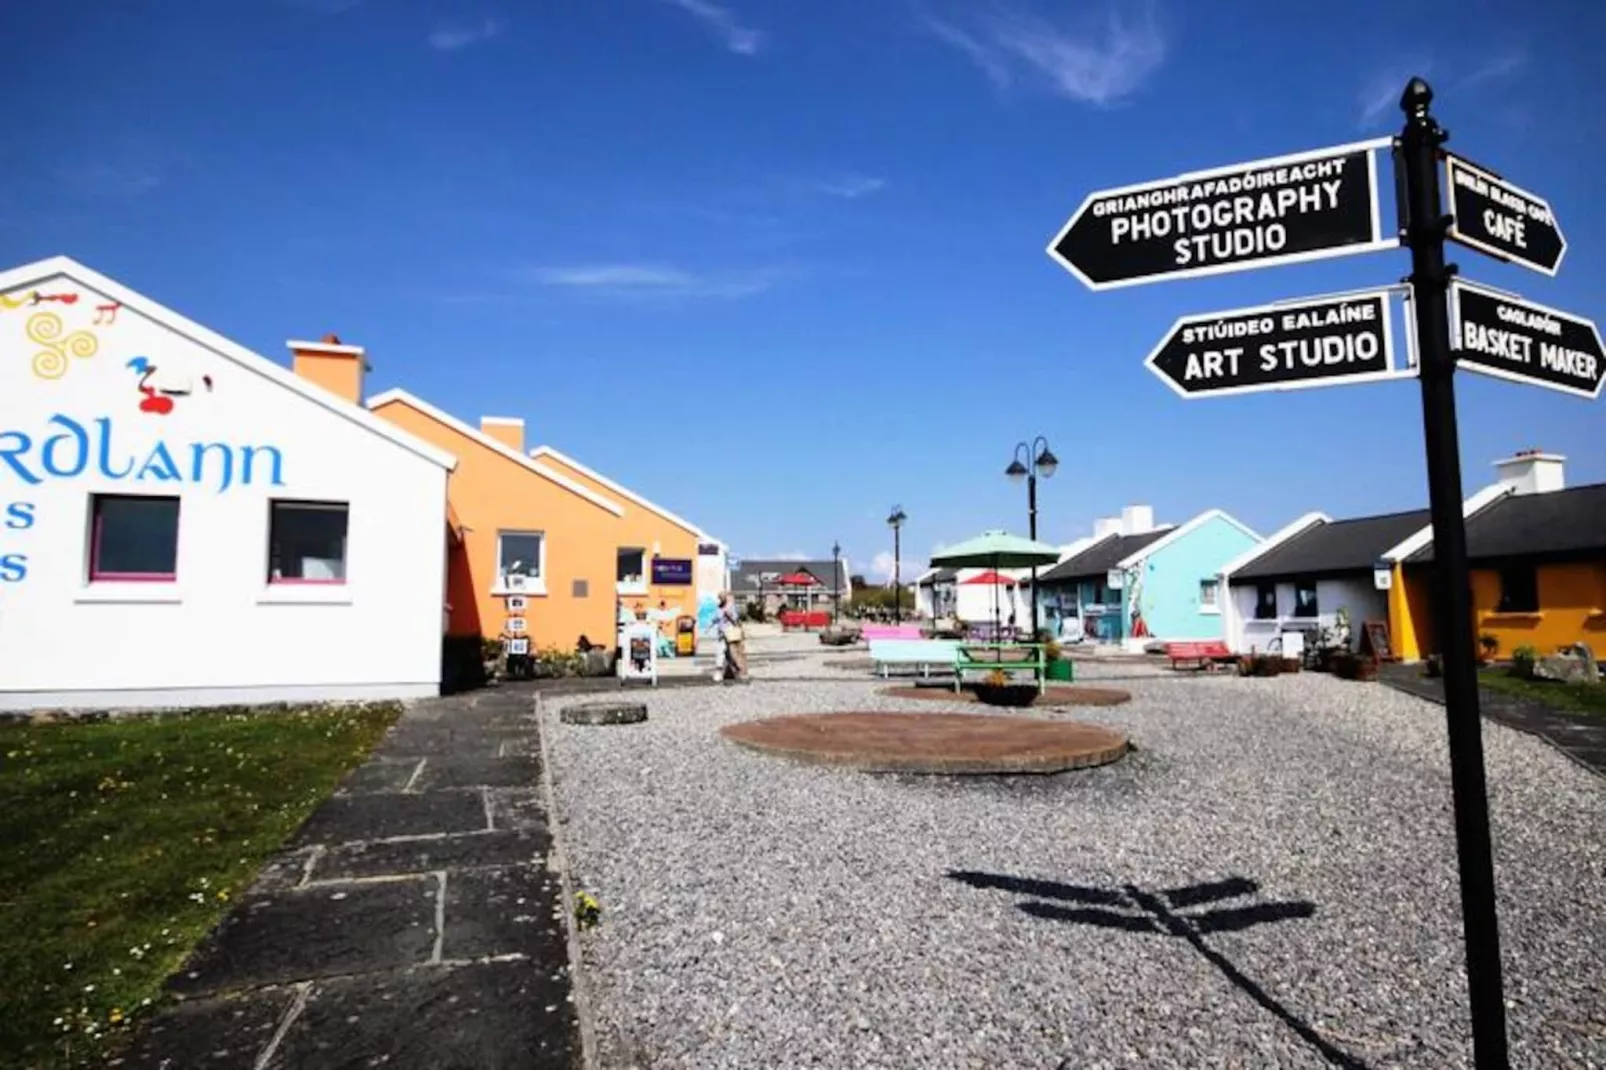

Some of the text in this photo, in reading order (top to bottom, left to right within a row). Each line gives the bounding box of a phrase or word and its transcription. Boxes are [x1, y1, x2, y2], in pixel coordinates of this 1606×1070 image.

[1092, 157, 1346, 217] GRIANGHRAFADÓIREACHT
[1111, 180, 1342, 245] PHOTOGRAPHY
[1482, 208, 1527, 249] CAFÉ
[1173, 223, 1287, 265] STUDIO
[1182, 303, 1375, 343] STIÚIDEO EALAÍNE
[1184, 331, 1379, 380] ART STUDIO
[1464, 321, 1598, 381] BASKET MAKER
